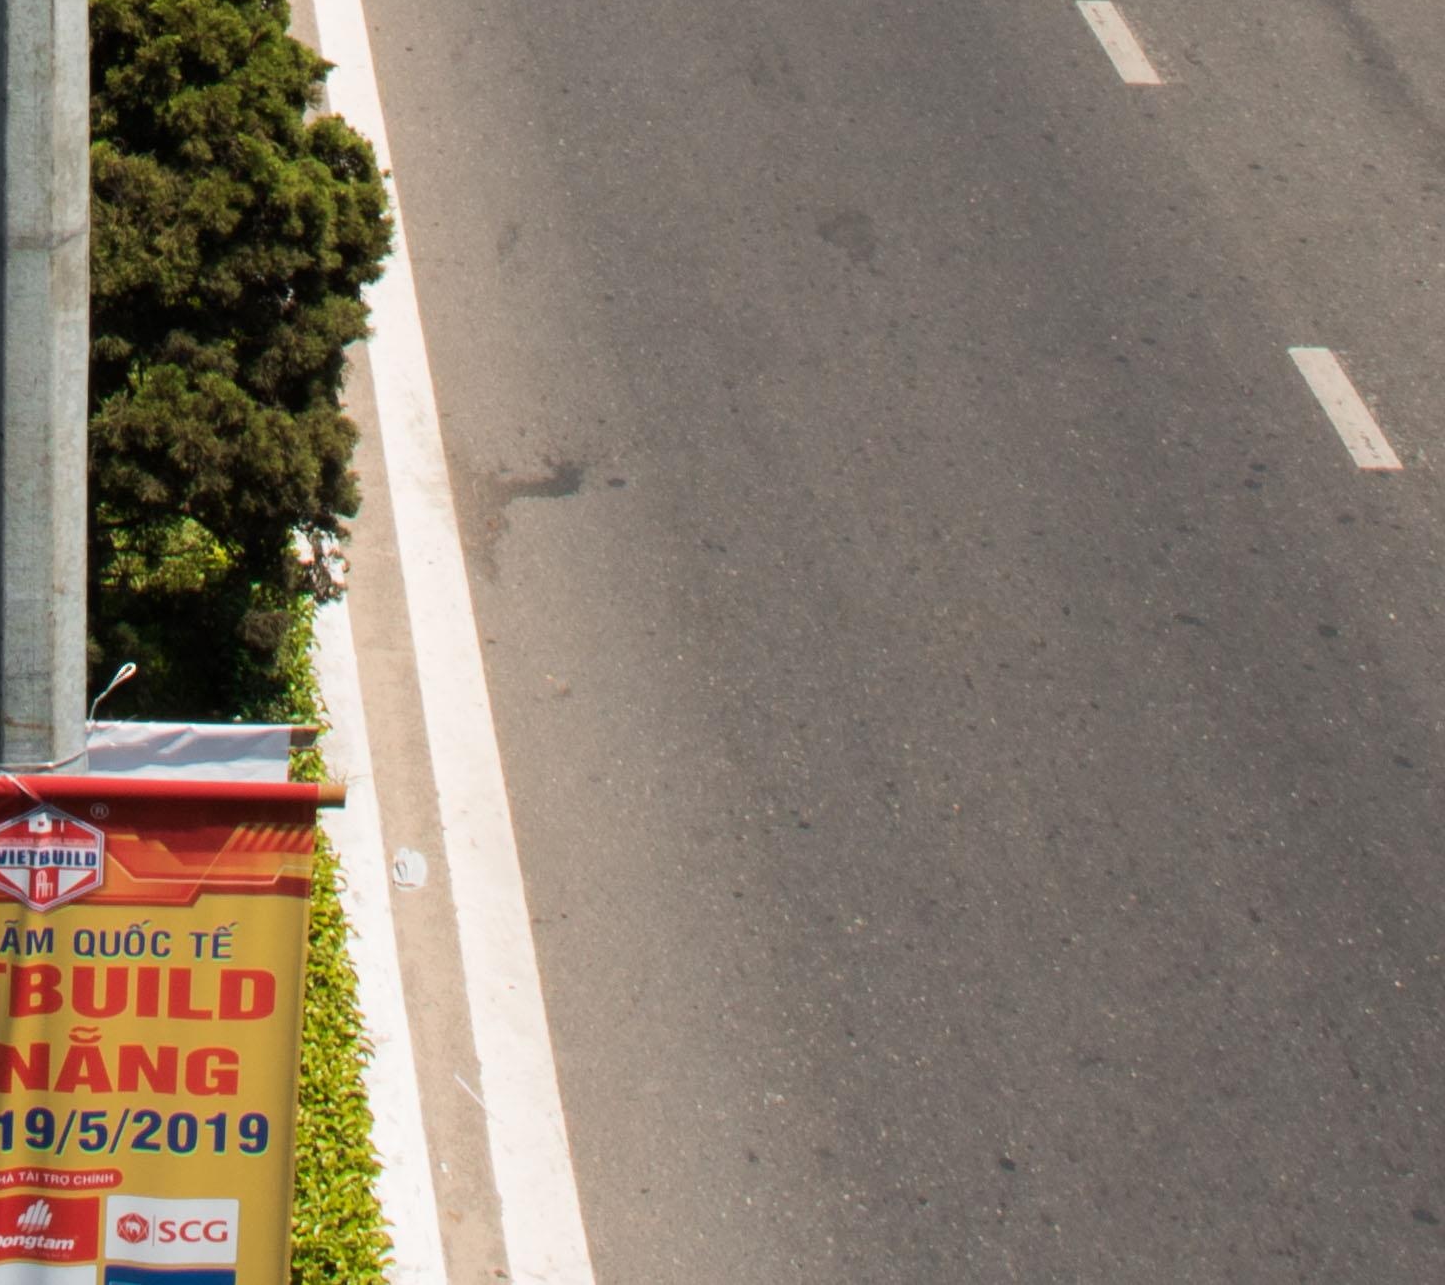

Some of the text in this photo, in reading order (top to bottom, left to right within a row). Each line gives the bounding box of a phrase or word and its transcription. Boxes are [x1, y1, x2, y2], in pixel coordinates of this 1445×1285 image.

[73, 920, 171, 958] QUỐC
[189, 921, 237, 959] TẾ
[18, 1169, 39, 1183] TÀI
[43, 1172, 70, 1186] TRỢ
[73, 1171, 114, 1186] CHÍNH
[158, 1221, 228, 1243] SCG
